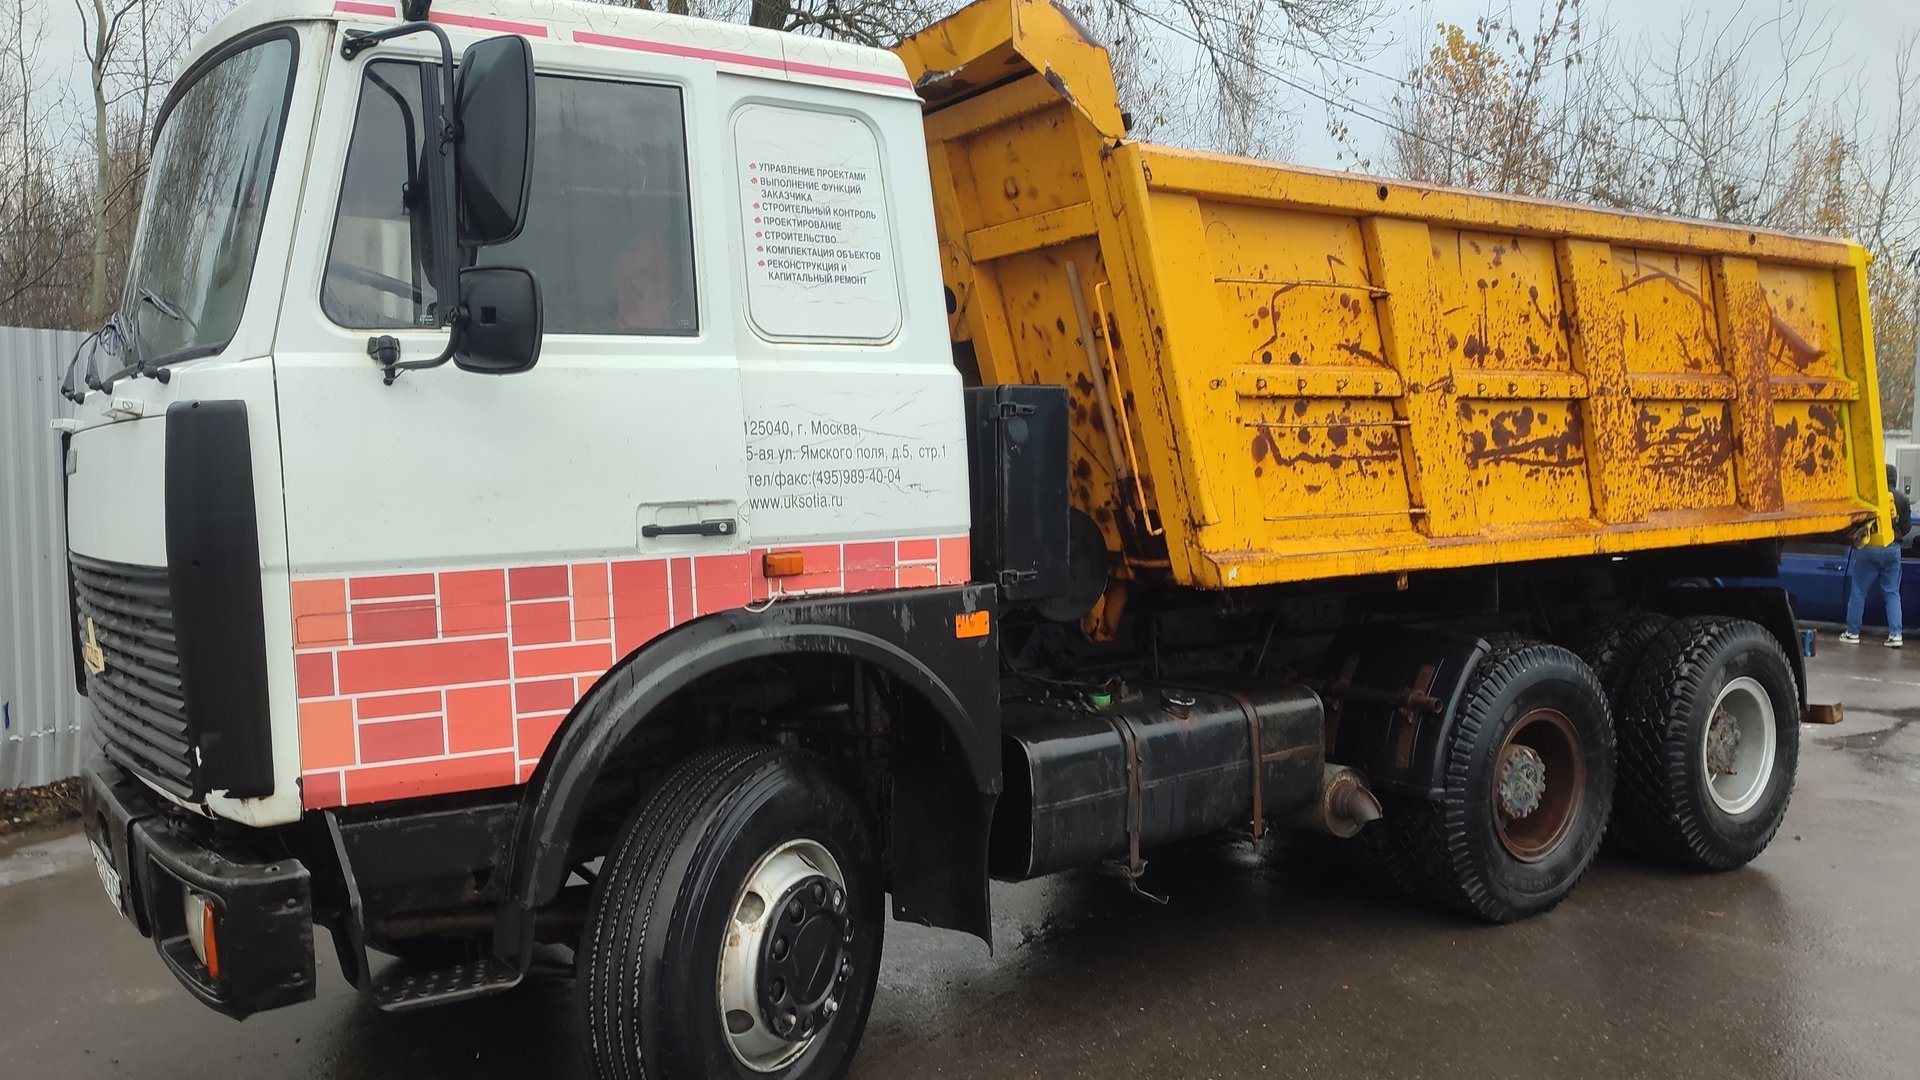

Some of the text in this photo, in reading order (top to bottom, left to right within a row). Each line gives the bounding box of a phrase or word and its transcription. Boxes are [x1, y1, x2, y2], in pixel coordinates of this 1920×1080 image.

[758, 163, 866, 181] УПРАВЛЕНИЕ ПРОЕКТАМИ
[760, 177, 861, 194] ВЫПОЛНЕНИЕ ФУНКЦИЙ
[761, 190, 812, 202] ЗАКАЗЧИКА
[762, 203, 876, 219] СТРОИТЕЛЬНЫЙ КОНТРОЛЬ
[764, 217, 841, 230] ПРОЕКТИРОВАНИЕ
[765, 231, 836, 243] СТРОИТЕЛЬСТВО
[766, 245, 881, 260] КОМПЛЕКТАЦИЯ ОБЪЕКТОВ
[767, 259, 847, 272] РЕКОНСТРУКЦИЯ И
[769, 272, 867, 284] КАПИТАЛЬНЫЙ РЕМОНТ
[798, 423, 807, 435] г.
[811, 420, 861, 437] Москва,
[746, 444, 946, 464] 5-ая ул. Ямского поля, д.5, стр.1
[749, 469, 901, 489] тел/факс:(495)989-40-04
[750, 493, 843, 509] www.uksotia.ru
